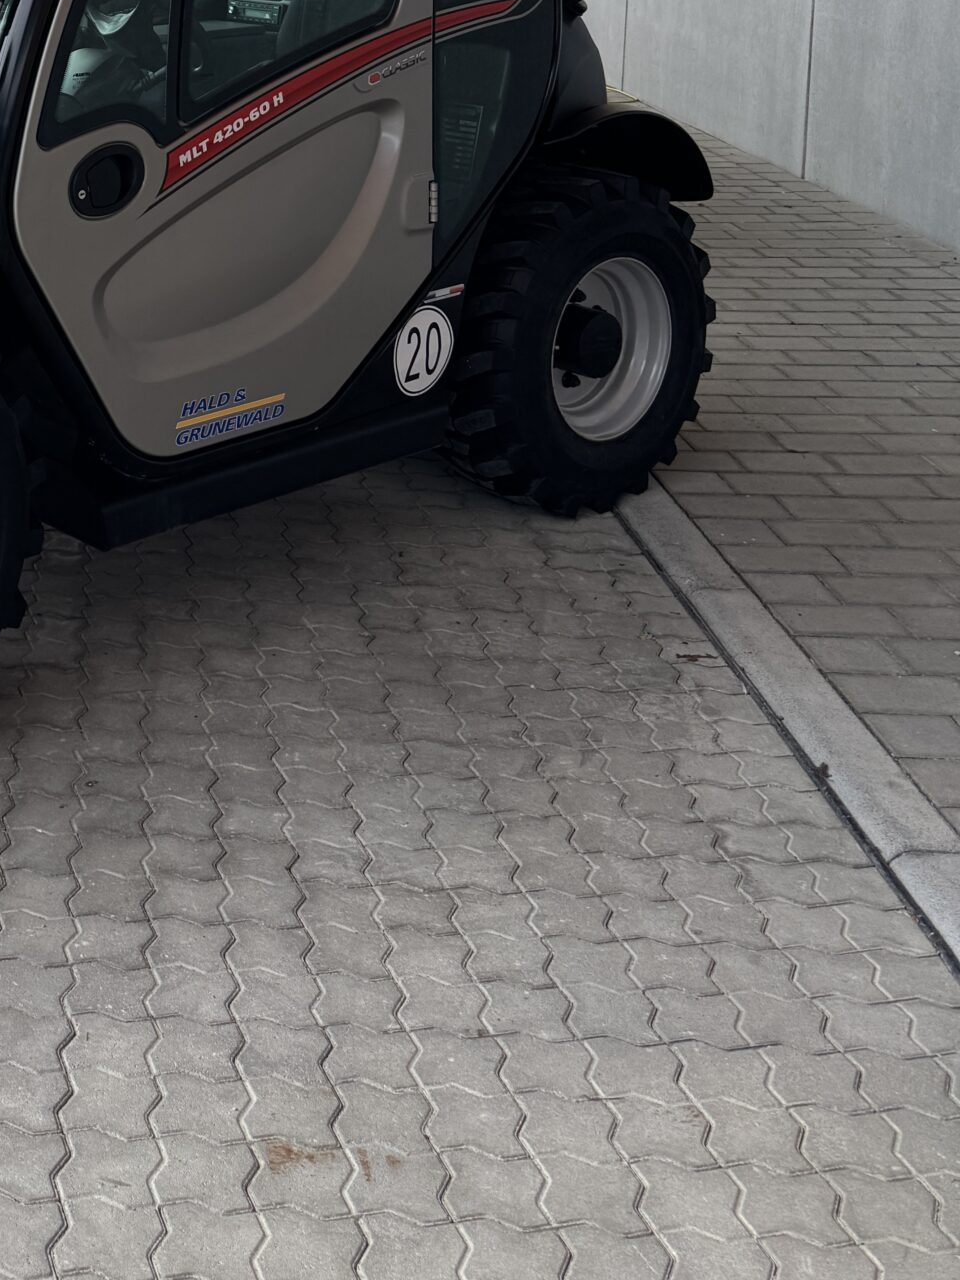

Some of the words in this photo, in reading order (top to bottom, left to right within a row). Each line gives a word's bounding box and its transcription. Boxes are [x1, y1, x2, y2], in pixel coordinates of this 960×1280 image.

[381, 50, 427, 79] CLASSIC
[179, 138, 209, 167] MLT
[213, 100, 270, 145] 420-60
[272, 91, 285, 108] H
[404, 322, 442, 384] 20
[181, 392, 231, 418] HALD
[234, 387, 247, 403] &
[176, 403, 286, 446] GRUNEWALD
